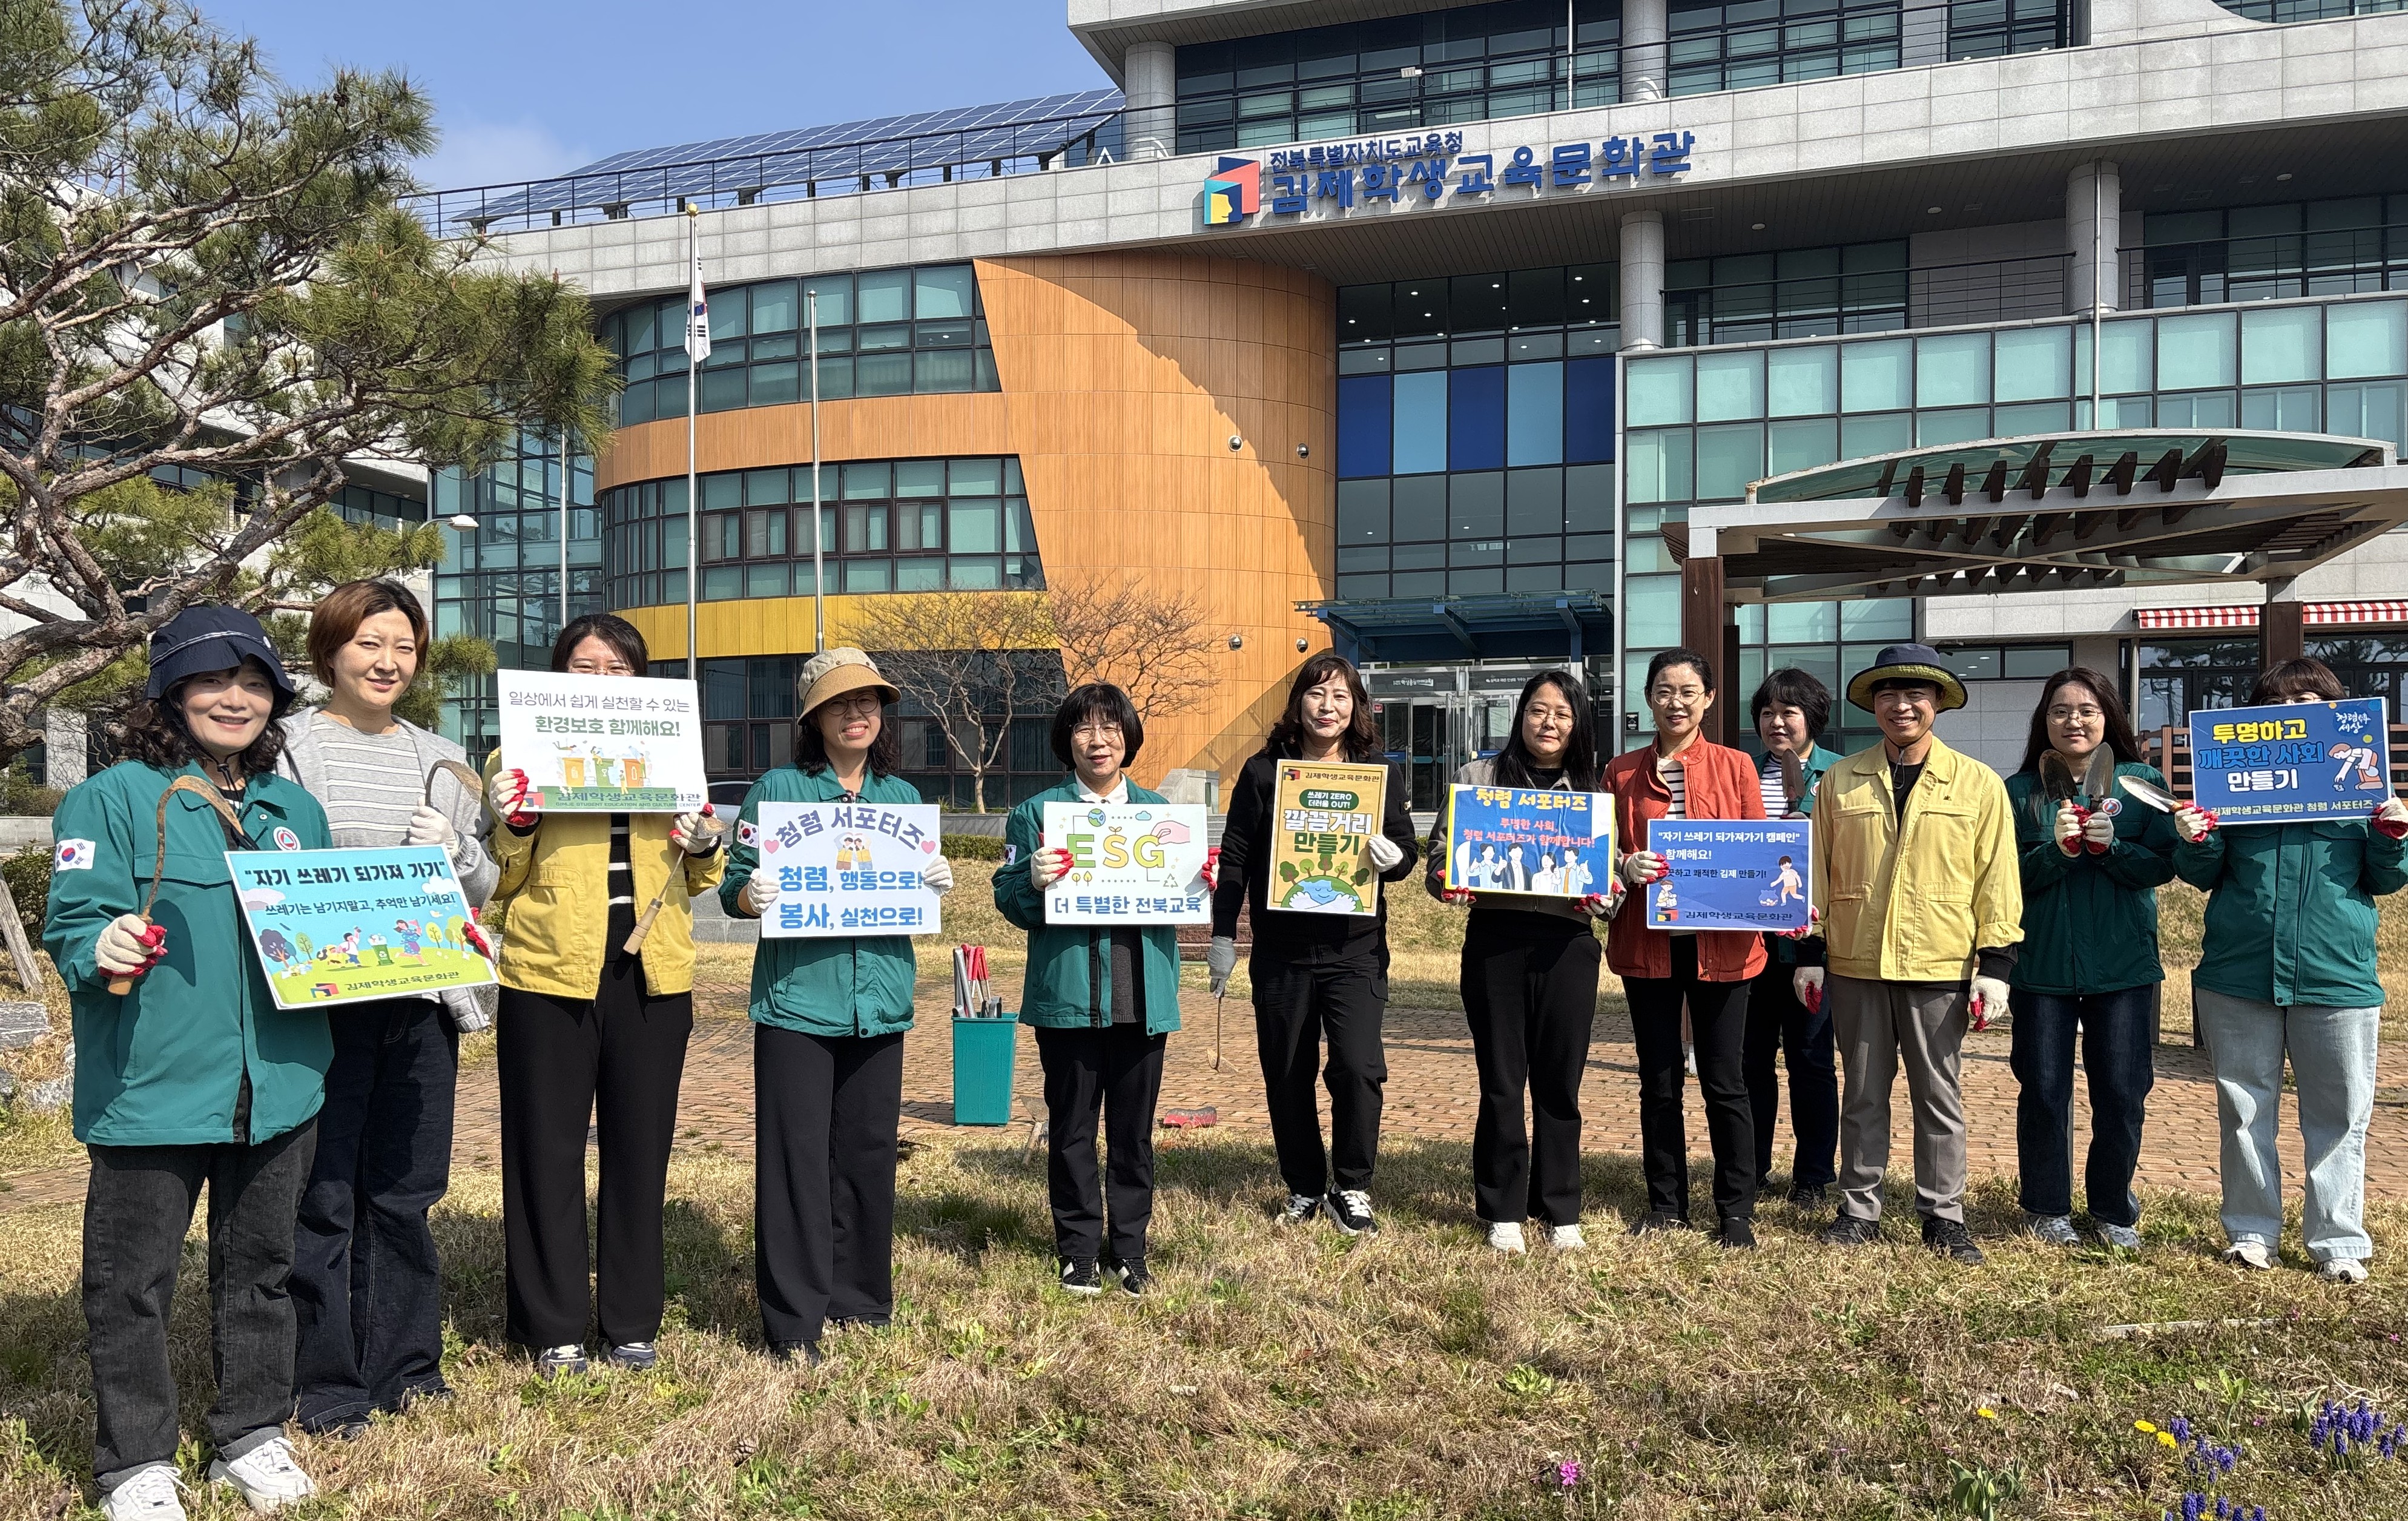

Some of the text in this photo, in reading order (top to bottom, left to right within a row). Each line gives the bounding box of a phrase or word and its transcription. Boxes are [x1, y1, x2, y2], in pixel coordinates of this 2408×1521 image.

[1270, 130, 1463, 173] 전북특별자치도교육청
[1273, 131, 1695, 214] 김제학생교육문화관
[509, 691, 690, 713] 일상에서 쉽게 실천할 수 있는
[535, 716, 681, 737] 환경보호 함께해요!
[2212, 719, 2308, 745] 투명하고
[2338, 722, 2364, 734] 세상
[2199, 741, 2325, 770] 깨끗한 사회
[1305, 772, 1380, 782] 김제학생교육문화관
[2227, 768, 2300, 793] 만들기
[555, 793, 701, 802] 김제학생교육문화관
[1476, 788, 1588, 811] 청렴 서포터즈
[2211, 799, 2374, 816] 김제학생교육문화관 청렴 서포터즈
[775, 806, 925, 851] 청렴 서포터즈
[1284, 809, 1373, 835] 깔끔거리
[1500, 817, 1531, 830] 투명한
[1294, 833, 1360, 856] 만들기
[1463, 828, 1595, 848] 청렴 서포터즈가 함께합니다!
[1658, 831, 1800, 843] "자기 쓰레기 되가져가기 캠페인"
[1067, 834, 1165, 868] ESG
[1665, 848, 1712, 860] 함께해요!
[245, 860, 446, 887] "자기 쓰레기 되가져 가기"
[778, 866, 923, 893] 청렴, 행동으로!
[1667, 868, 1767, 879] 끗하고 쾌적한 김제 만들기!
[265, 894, 456, 916] 쓰레기는 남기지말고, 추억만 남기세요!
[779, 902, 923, 930] 봉사, 실천으로!
[1055, 896, 1201, 914] 더 특별한 전북교육
[1684, 911, 1793, 922] 김제학생교육문화관
[346, 971, 460, 991] 김제학생교육문화관
